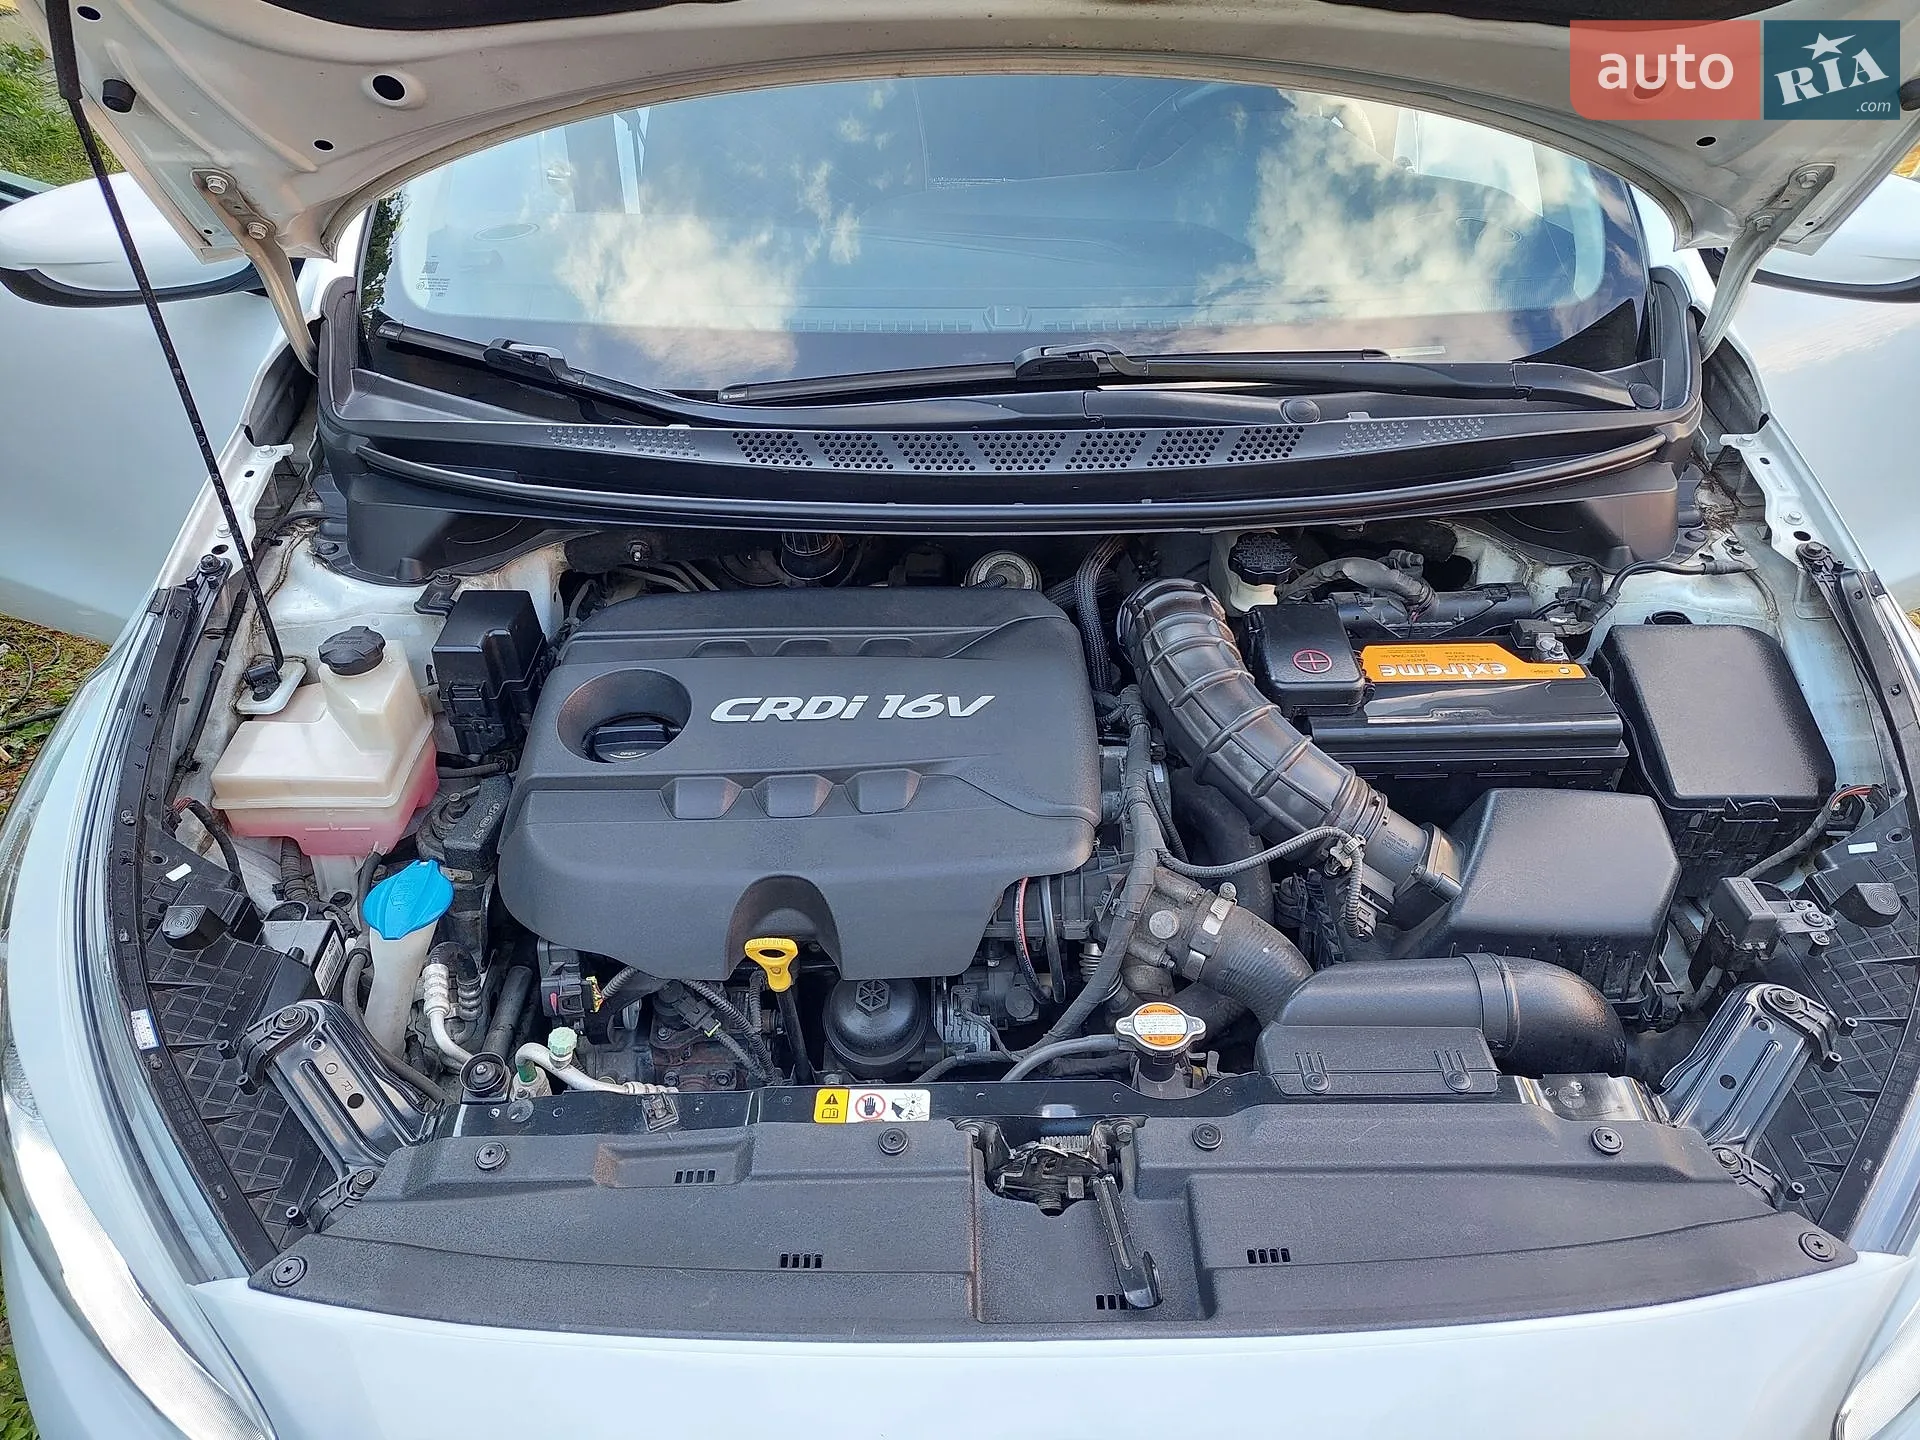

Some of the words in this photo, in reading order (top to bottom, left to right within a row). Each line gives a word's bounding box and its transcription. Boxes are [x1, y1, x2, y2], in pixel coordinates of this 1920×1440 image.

[1379, 662, 1507, 679] extreme
[710, 695, 869, 722] CRDi
[878, 693, 996, 719] 16V
